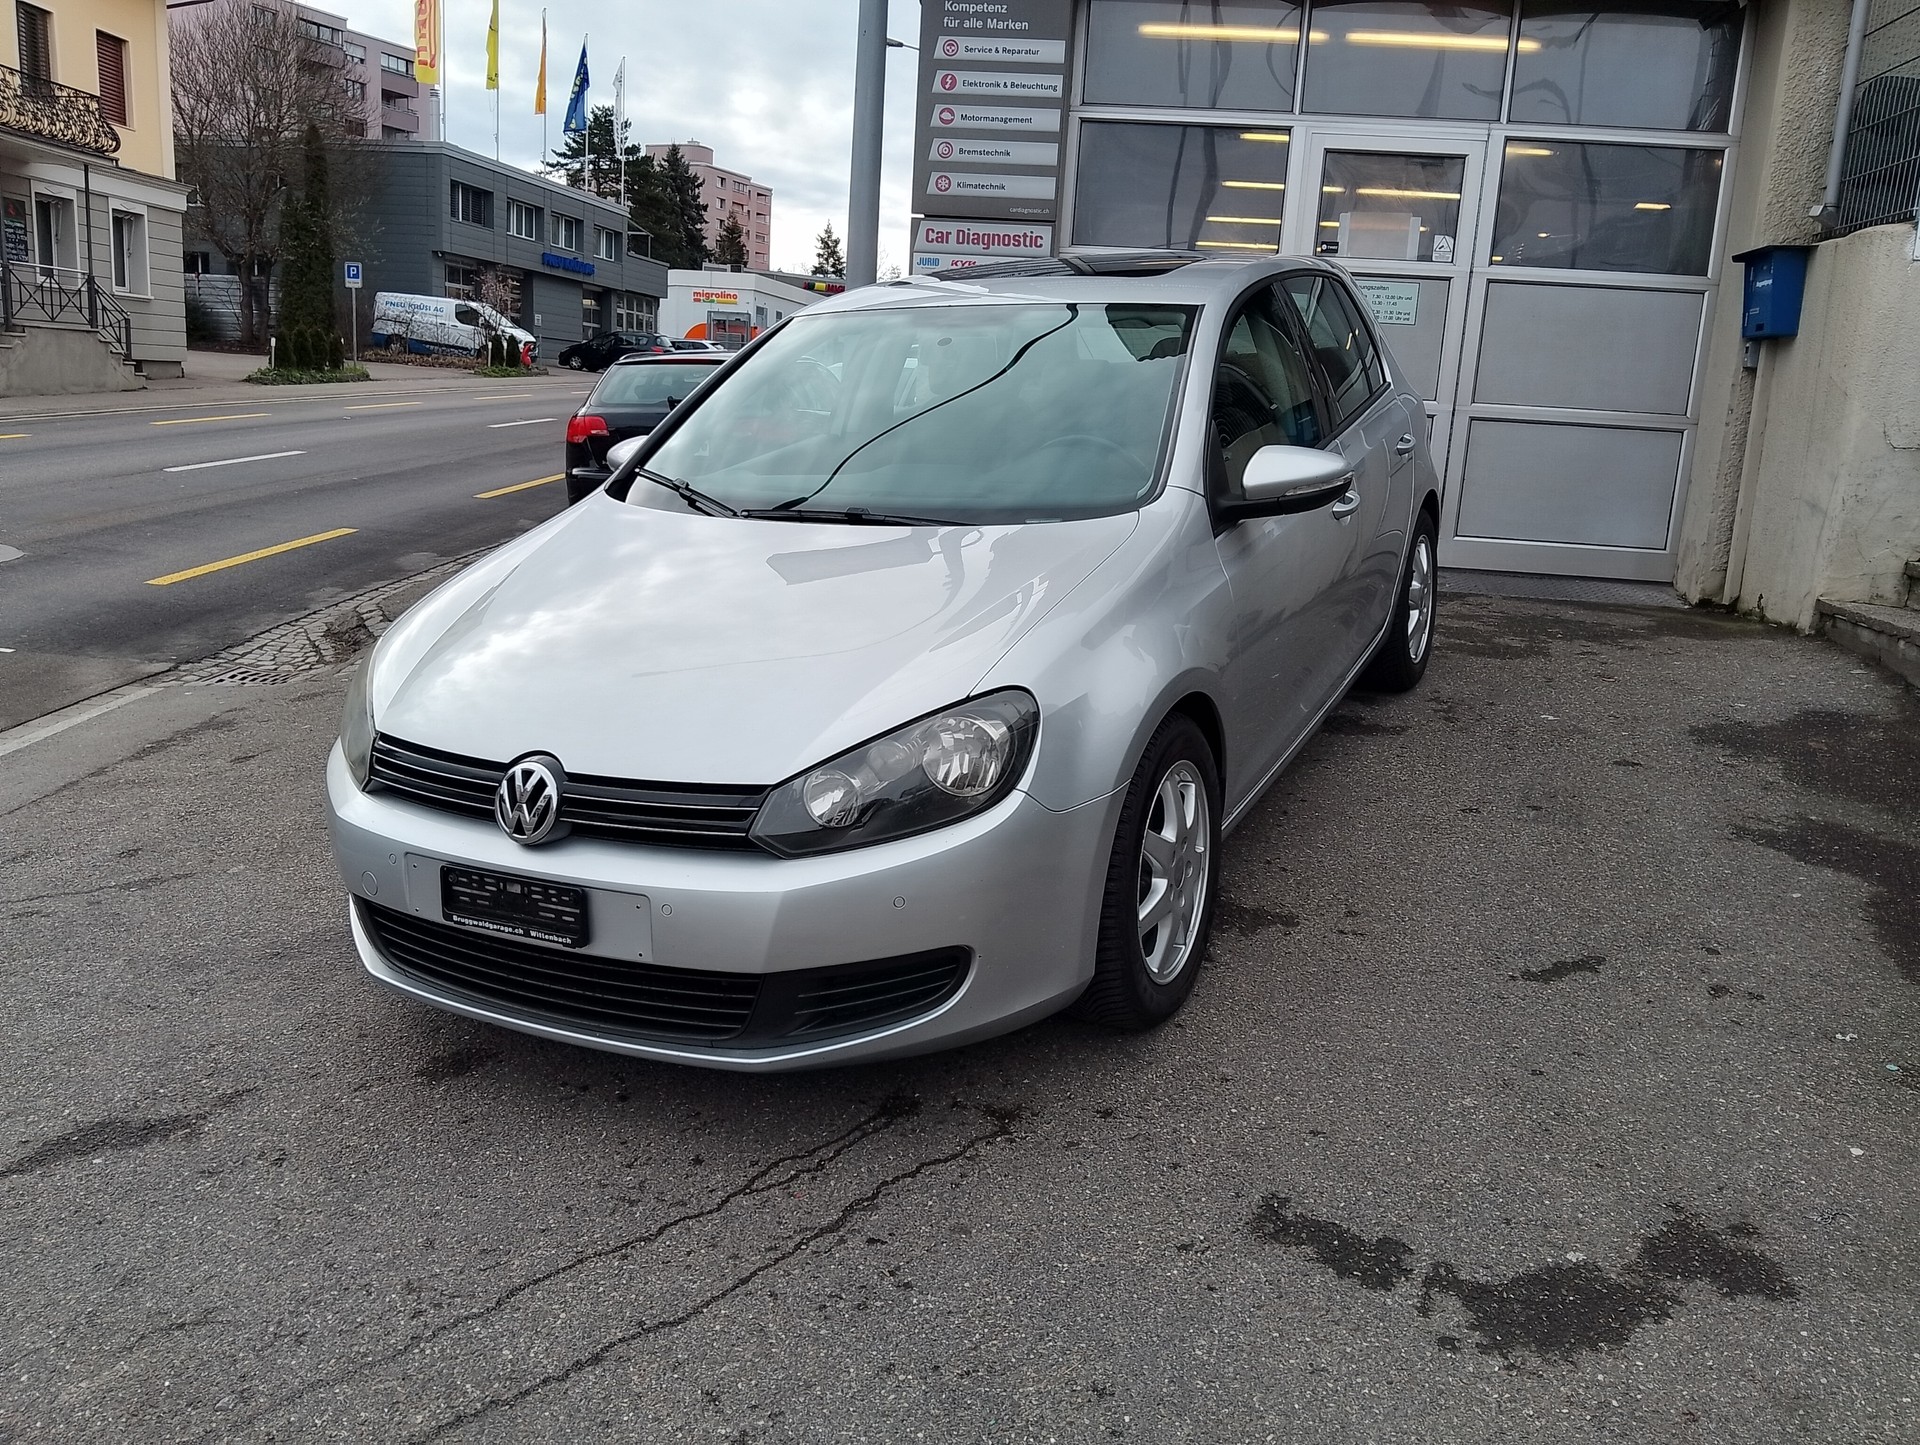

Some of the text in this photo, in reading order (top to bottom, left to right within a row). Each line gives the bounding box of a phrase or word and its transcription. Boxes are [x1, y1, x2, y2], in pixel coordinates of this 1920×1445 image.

[944, 0, 1008, 14] Kompetenz
[943, 16, 1029, 30] für alle Marken
[964, 45, 1040, 56] Service & Reparatur
[962, 79, 1001, 89] Elektronik
[1010, 81, 1058, 92] Beleuchtung
[960, 113, 1033, 125] Motormanagement
[958, 147, 1011, 157] Bremstechnik
[956, 181, 1006, 191] Klimatechnik
[925, 227, 1044, 251] Car Diagnostic
[916, 256, 940, 267] JURID
[692, 290, 738, 300] migrolino
[385, 300, 406, 308] PNEU
[452, 915, 572, 944] Bruggwaldgarage.ch Wittenbach
